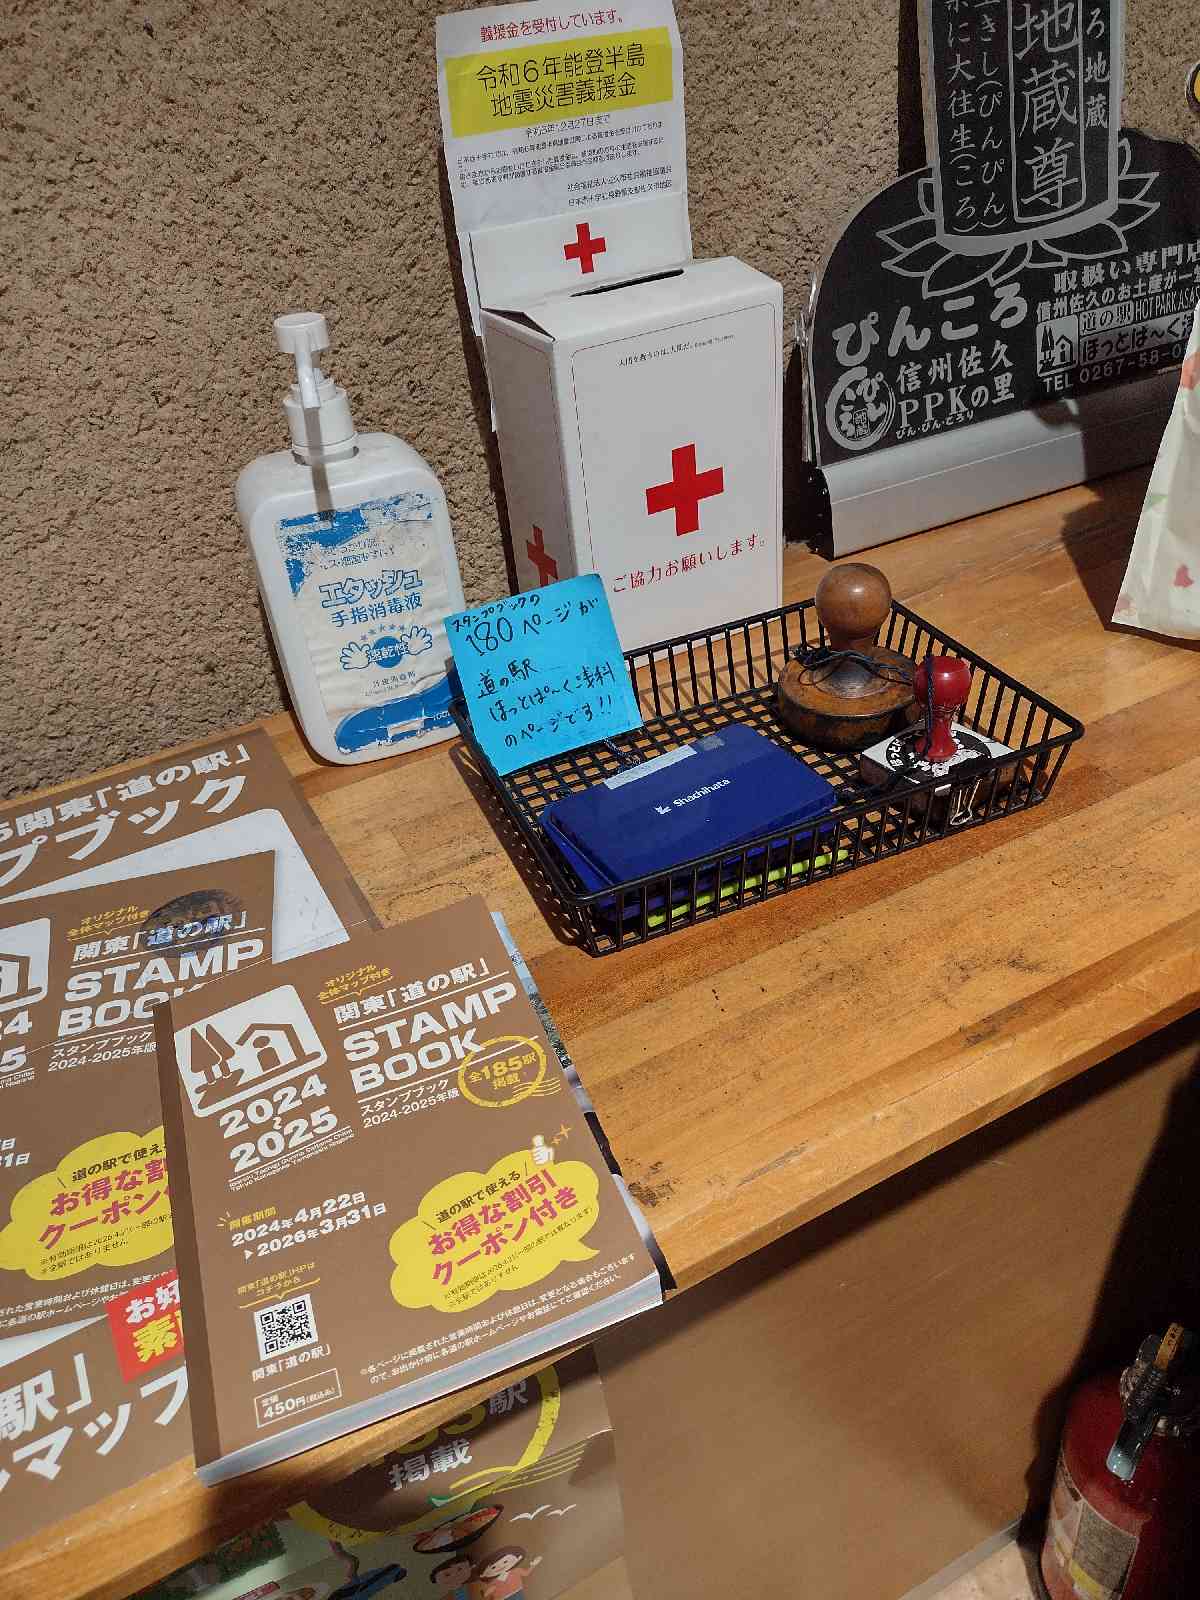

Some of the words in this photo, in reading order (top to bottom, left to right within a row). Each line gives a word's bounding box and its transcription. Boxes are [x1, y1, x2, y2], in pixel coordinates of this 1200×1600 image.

[479, 8, 624, 42] 義援金を受付しています。
[476, 42, 645, 91] 令和6年能登半島
[491, 72, 638, 117] 地震災害義援金
[832, 282, 1028, 367] ぴんころ
[1082, 302, 1131, 335] 道の駅
[1135, 296, 1154, 320] HOT
[1155, 289, 1177, 317] PARK
[896, 339, 1015, 395] 信州佐久
[1043, 376, 1074, 394] TEL
[1079, 342, 1187, 384] 0267-58-0
[897, 371, 1017, 429] PPKの里
[319, 569, 423, 608] エタッシュ
[613, 533, 766, 593] ご協力お願いします。
[331, 594, 424, 628] 手指消毒液
[452, 593, 541, 633] スタンプブックの
[477, 657, 539, 700] 道の駅
[672, 779, 731, 807] Shachihata
[73, 910, 247, 962] 関東「道の駅」
[64, 938, 264, 1001] STAMP
[333, 957, 491, 1024] 関東「道の駅」
[57, 982, 206, 1037] BOO
[343, 982, 518, 1062] STAMP
[350, 1027, 486, 1094] BOOK
[219, 1073, 328, 1139] 2024
[360, 1079, 450, 1117] スタンプブック
[363, 1087, 460, 1128] 2024-2025年版
[229, 1105, 338, 1173] 2025
[38, 1184, 175, 1250] クーポン
[231, 1190, 366, 1248] 2024年4月22日
[427, 1168, 558, 1256] お得な割引
[436, 1169, 521, 1224] 道の駅で使える
[257, 1202, 387, 1257] 2026年3月31日
[431, 1186, 580, 1286] クーポン付き
[132, 1312, 184, 1363] 素
[251, 1342, 332, 1382] 関東「道の駅」
[388, 1438, 473, 1491] 掲載
